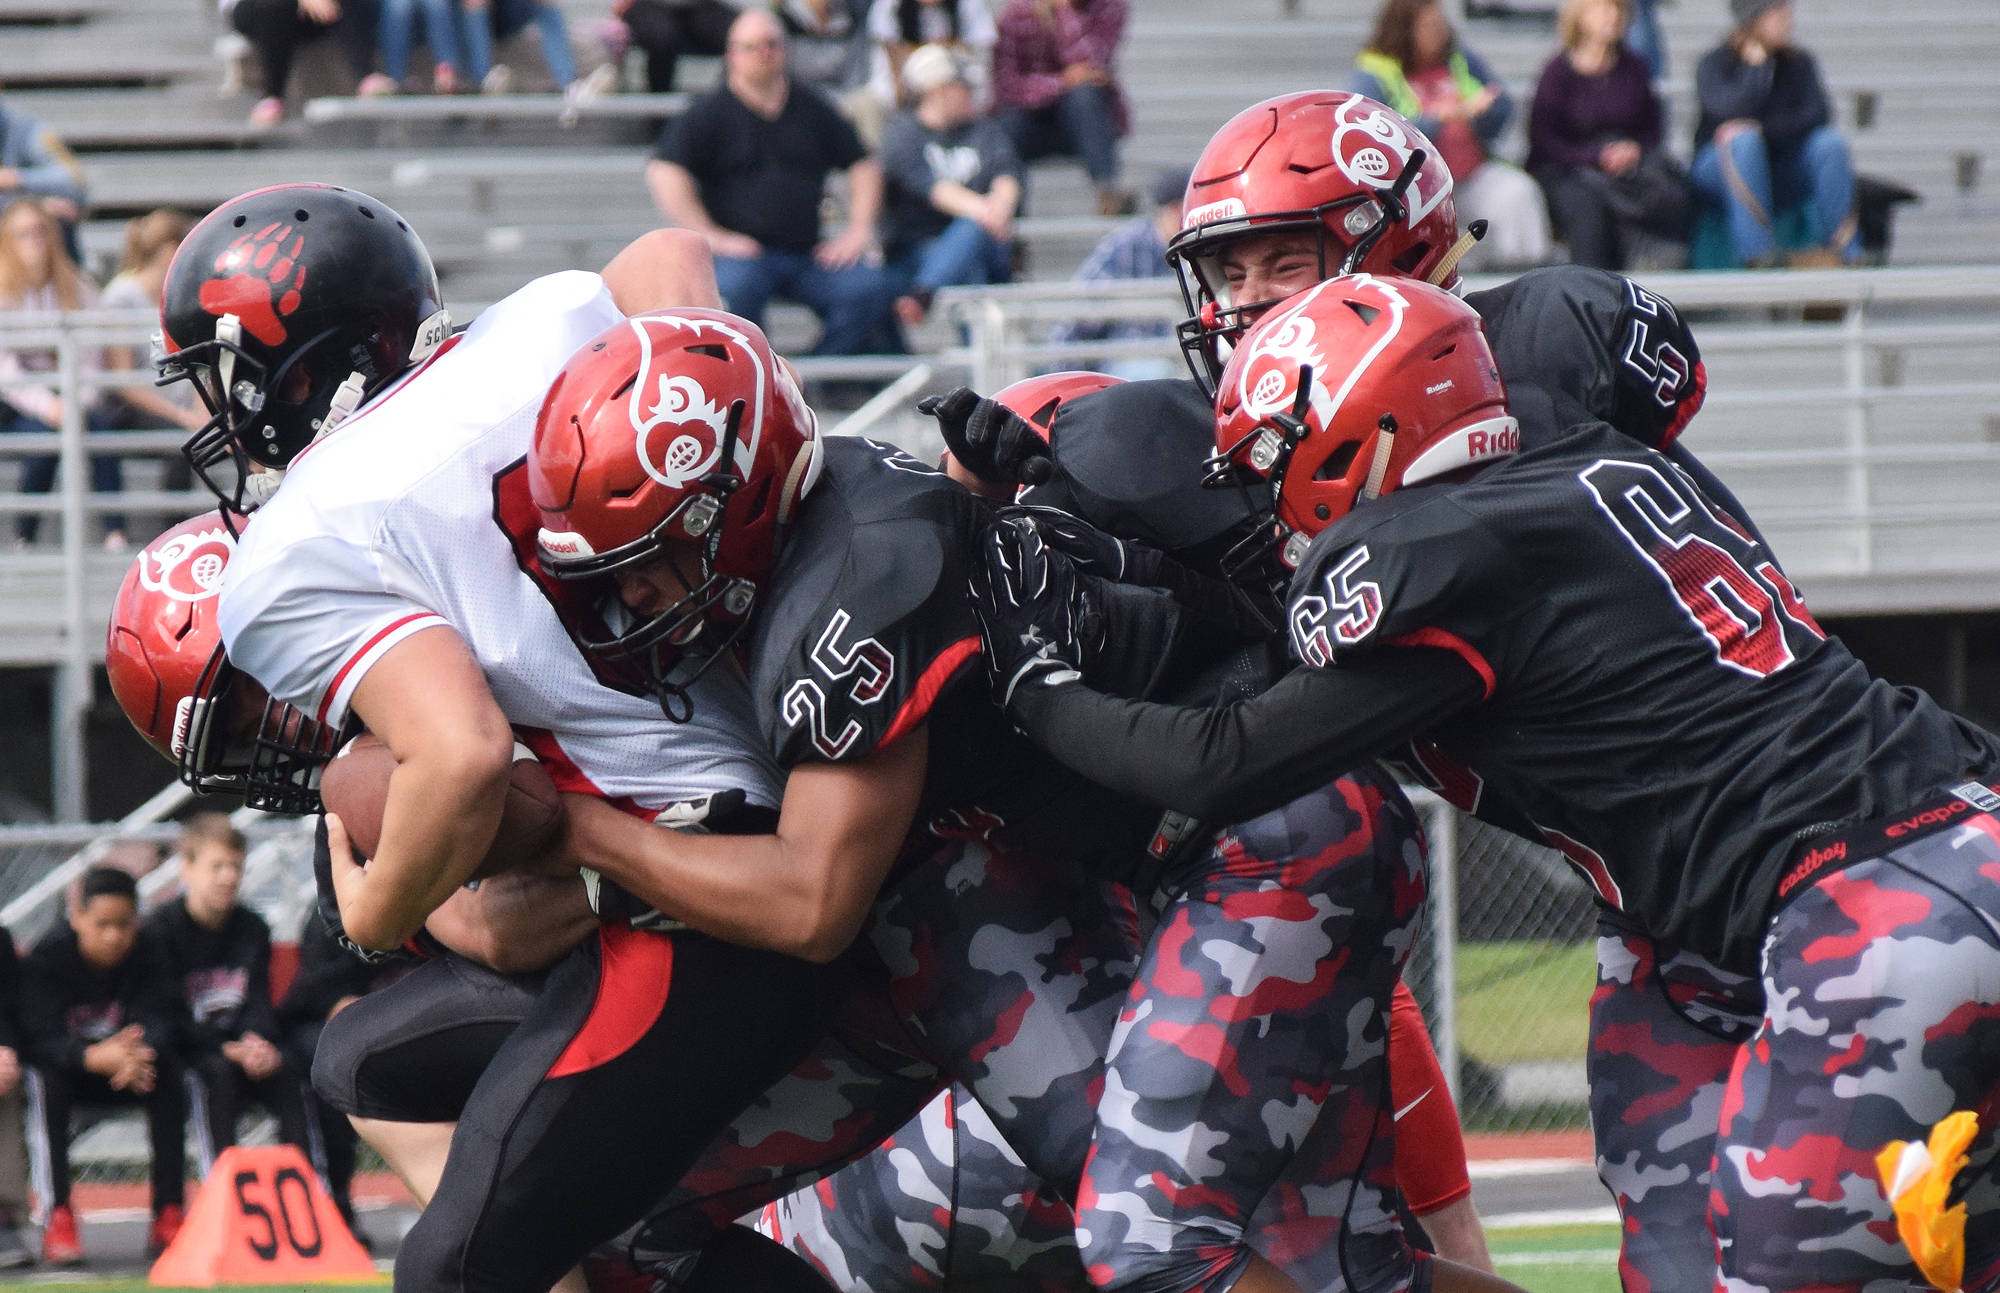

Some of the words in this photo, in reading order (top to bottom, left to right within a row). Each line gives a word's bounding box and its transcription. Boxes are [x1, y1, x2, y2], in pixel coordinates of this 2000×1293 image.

[1188, 204, 1233, 227] Riddell
[1467, 425, 1520, 458] Ridd
[1291, 545, 1383, 668] 65
[783, 608, 895, 760] 25
[1885, 801, 1967, 838] evapo
[234, 1168, 322, 1261] 50
